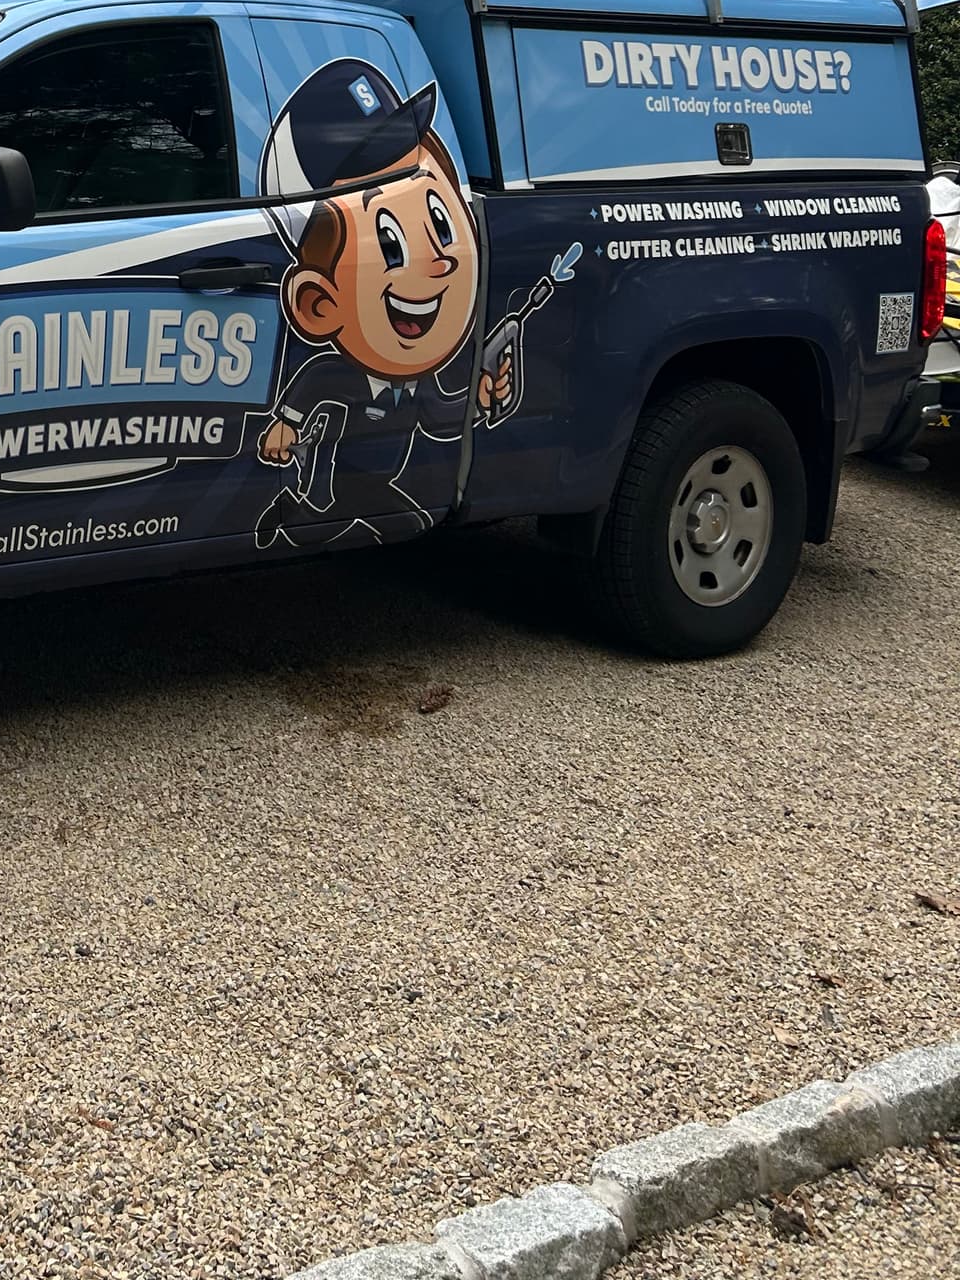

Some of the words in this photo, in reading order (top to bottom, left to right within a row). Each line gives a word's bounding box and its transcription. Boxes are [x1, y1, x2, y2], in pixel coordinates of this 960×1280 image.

[581, 40, 702, 89] DIRTY
[711, 45, 852, 93] HOUSE?
[356, 83, 375, 108] S
[645, 96, 670, 113] Call
[672, 97, 711, 116] Today
[712, 97, 731, 113] for
[734, 101, 742, 114] a
[744, 99, 771, 114] Free
[773, 99, 813, 115] Quote!
[601, 203, 664, 223] POWER
[665, 201, 743, 220] WASHING
[764, 198, 830, 217] WINDOW
[833, 196, 901, 214] CLEANING
[607, 239, 672, 260] GUTTER
[675, 235, 755, 257] CLEANING
[771, 232, 827, 252] SHRINK
[828, 228, 902, 249] WRAPPING
